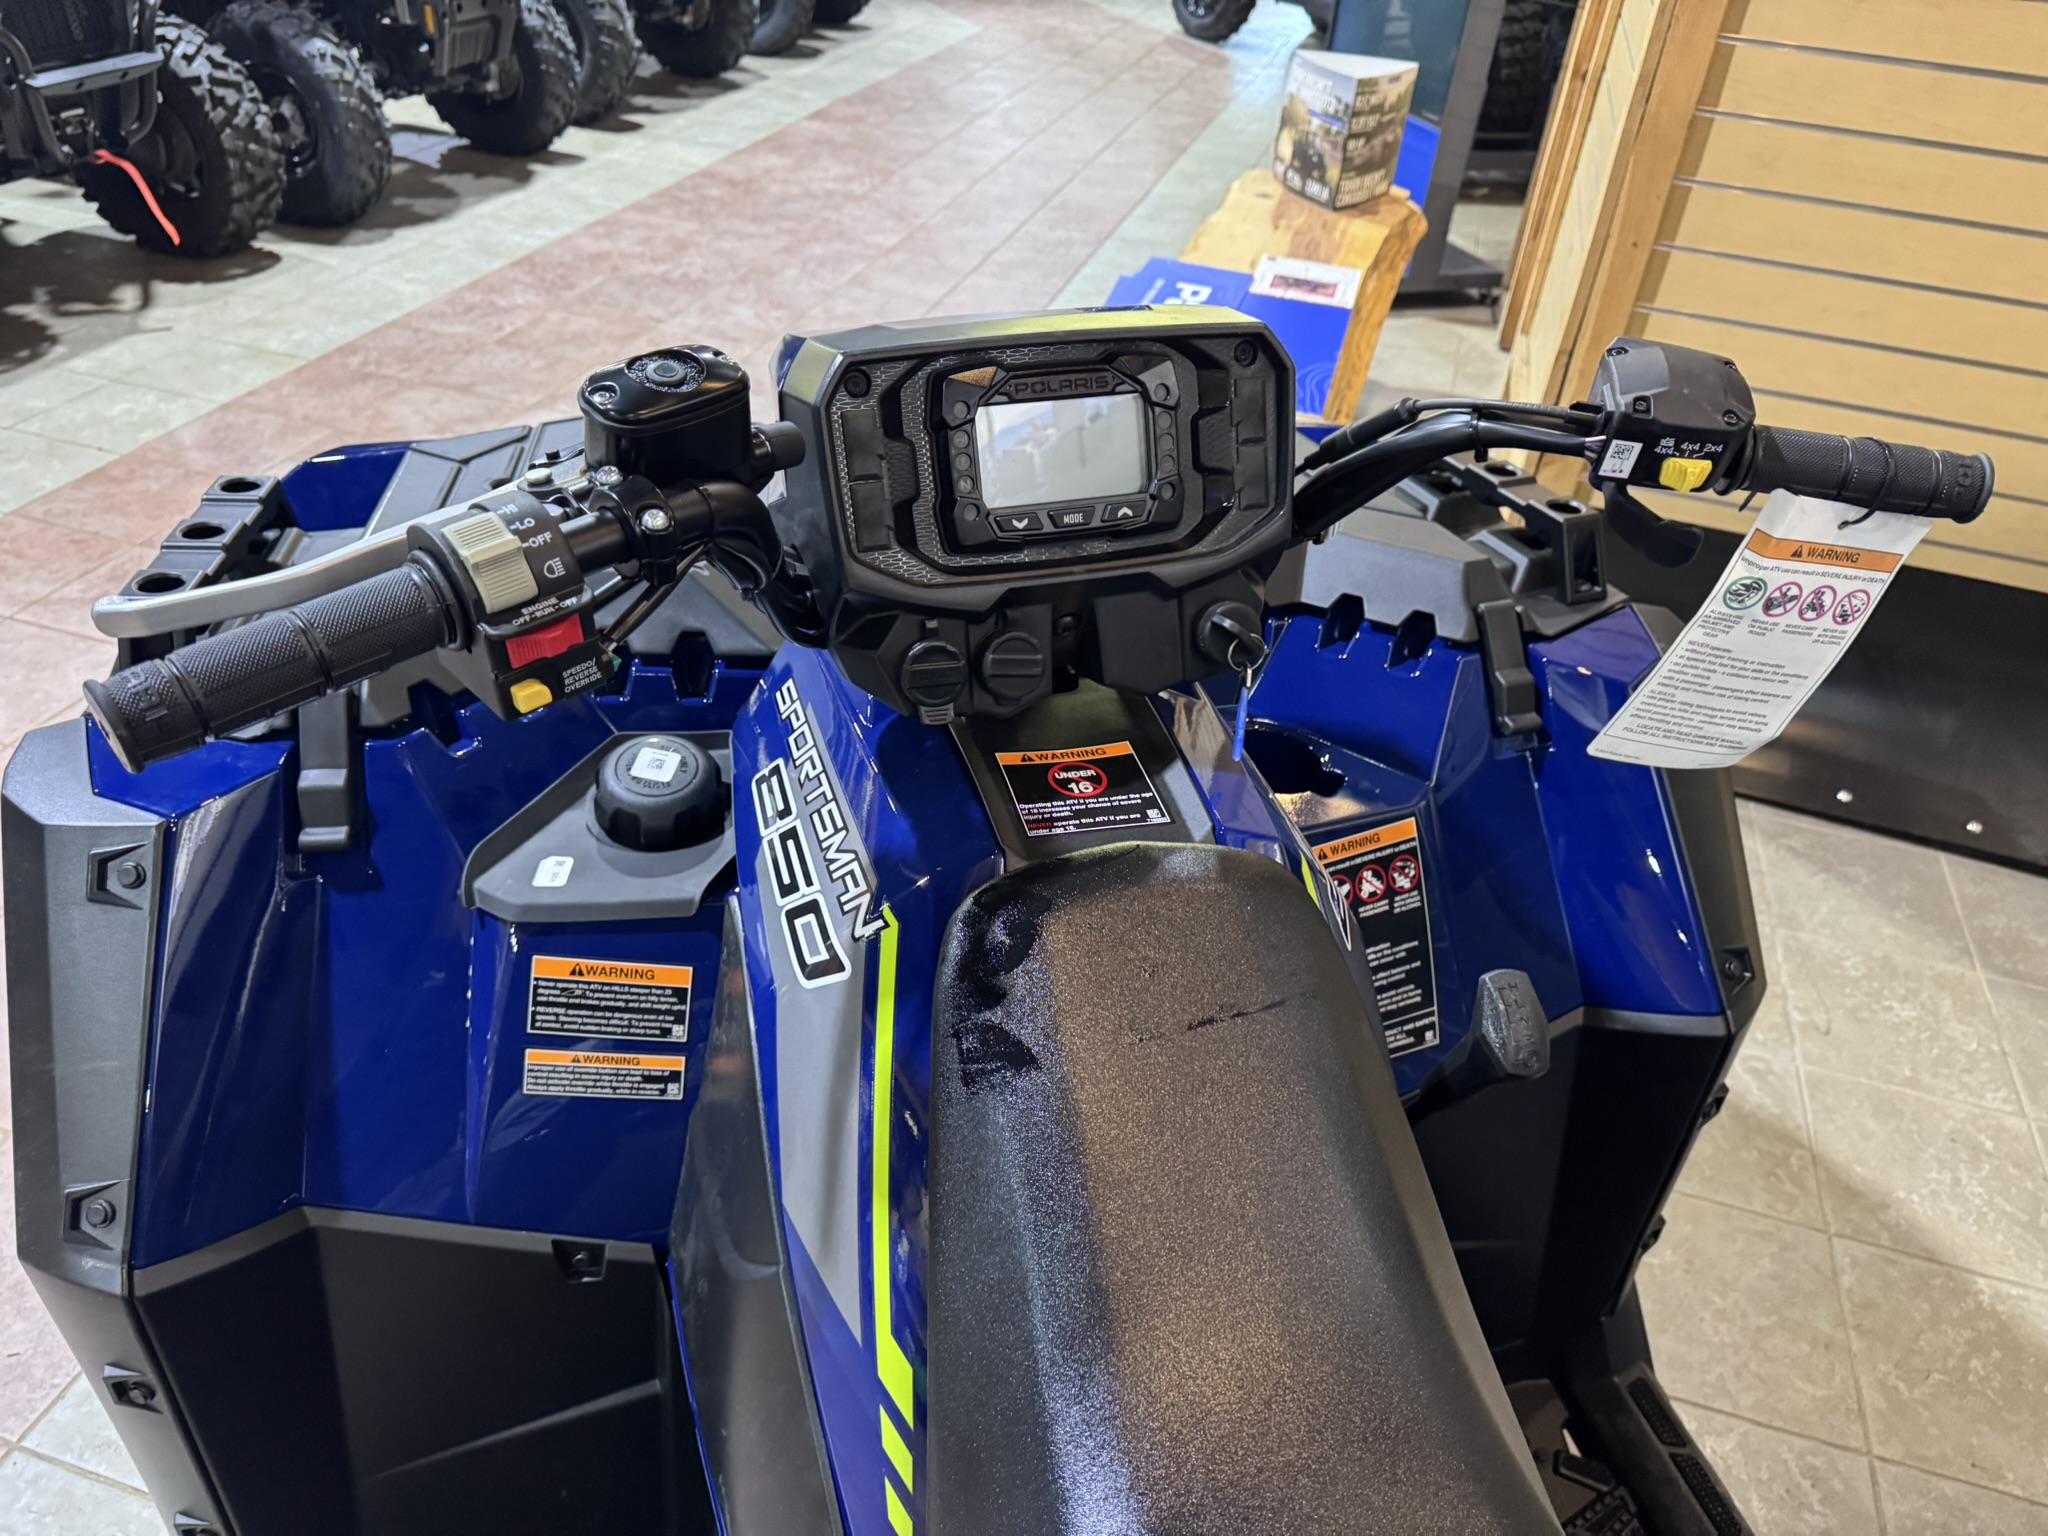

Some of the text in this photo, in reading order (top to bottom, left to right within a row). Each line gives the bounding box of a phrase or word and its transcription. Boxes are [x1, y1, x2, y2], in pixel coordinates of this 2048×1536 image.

[1014, 376, 1110, 395] POLARIS
[1654, 442, 1724, 455] 4x4 4x4 2x4
[516, 518, 536, 530] LO
[1063, 513, 1084, 524] MODE
[529, 532, 552, 548] OFF
[1807, 547, 1861, 564] WARNING
[1741, 556, 1770, 571] Improper
[1820, 570, 1842, 580] SEVERE
[521, 597, 560, 615] ENGINE
[562, 657, 596, 678] SPEEDO/
[564, 666, 600, 686] REVERSE
[564, 672, 602, 693] OVERRIDE
[1035, 748, 1107, 762] WARNING
[1054, 769, 1097, 780] UNDER
[1068, 782, 1094, 794] 16
[775, 678, 887, 941] SPORTSMAN
[1018, 801, 1052, 810] Operating
[1052, 818, 1081, 827] operate
[1330, 833, 1381, 856] WARNING
[751, 757, 852, 990] 850
[586, 965, 655, 980] WARNING
[583, 1055, 640, 1066] WARNING
